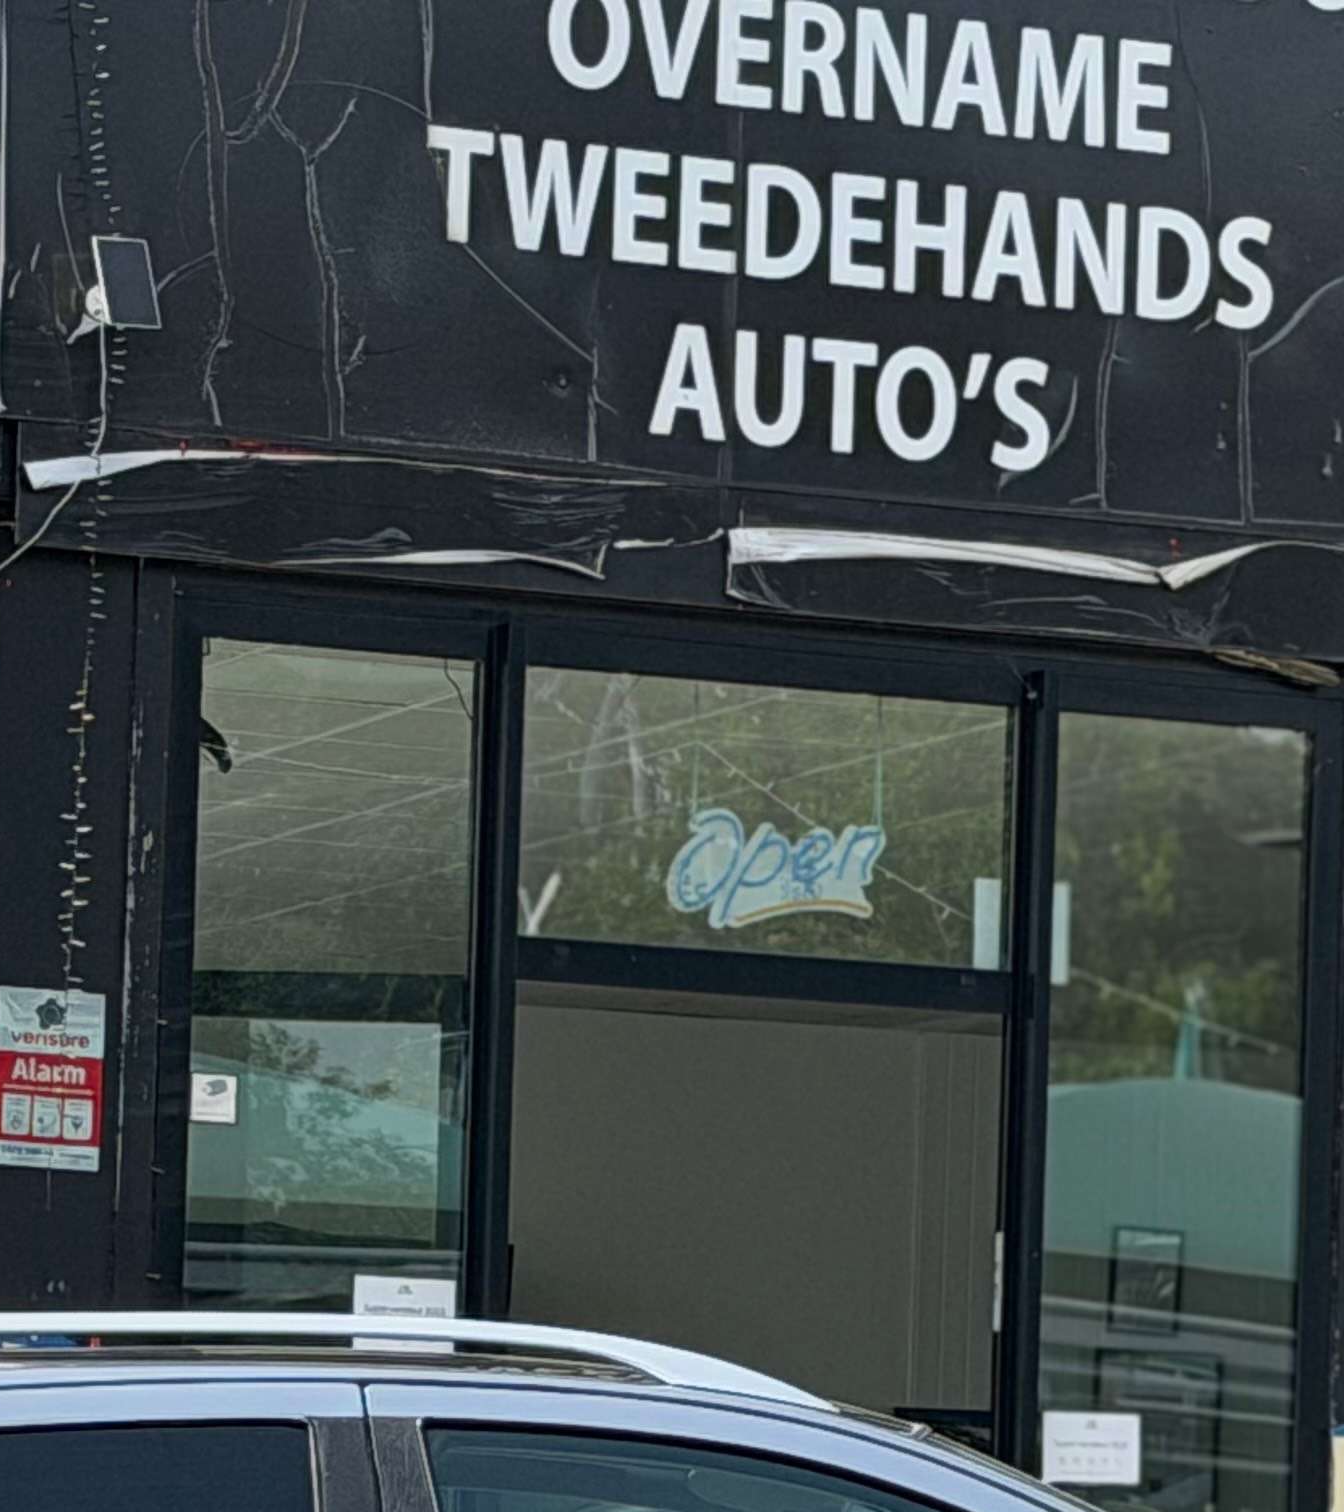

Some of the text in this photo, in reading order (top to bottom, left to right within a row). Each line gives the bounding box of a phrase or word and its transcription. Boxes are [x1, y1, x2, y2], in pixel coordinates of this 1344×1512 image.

[547, 0, 1172, 155] OVERNAME
[427, 125, 1274, 331] TWEEDEHANDS
[649, 322, 1048, 471] AUTO'S
[670, 811, 884, 925] Open
[11, 1058, 86, 1085] Alarm
